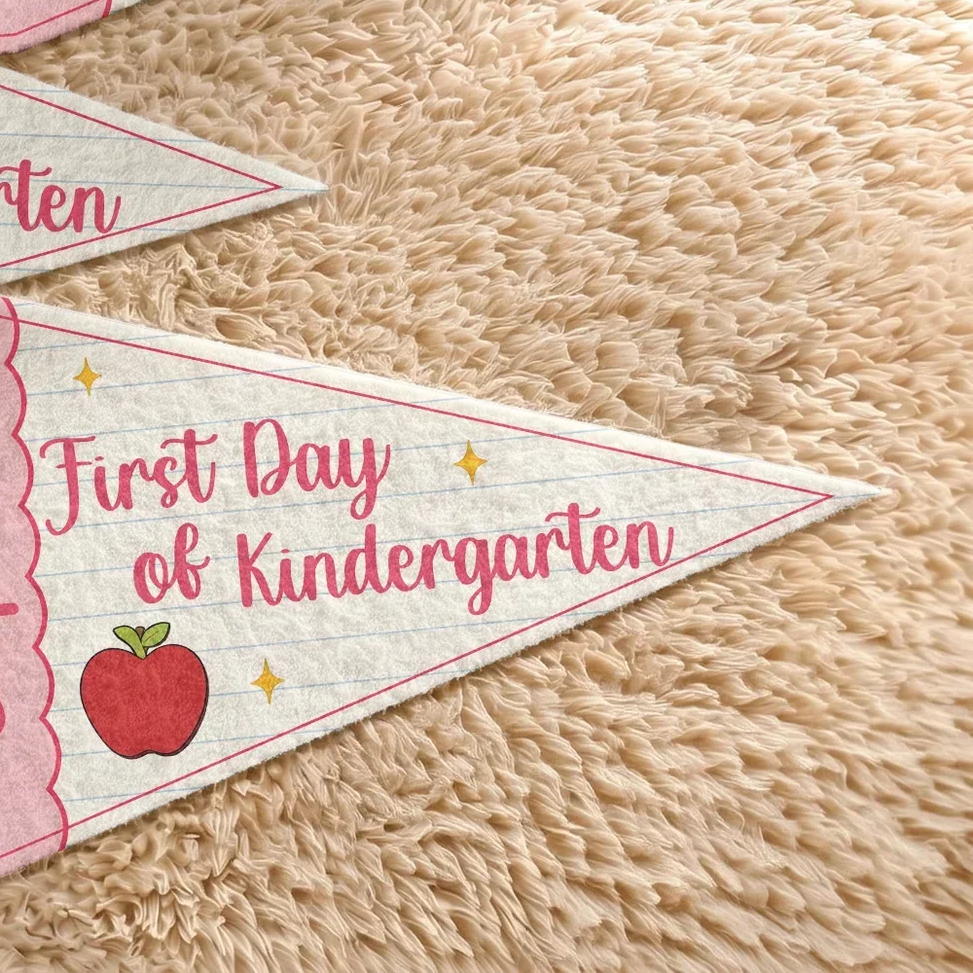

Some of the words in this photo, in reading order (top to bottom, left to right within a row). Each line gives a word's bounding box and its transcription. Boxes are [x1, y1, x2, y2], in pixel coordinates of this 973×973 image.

[39, 429, 217, 535] First
[244, 419, 391, 519] Day
[133, 523, 211, 603] of
[238, 504, 675, 616] Kindergarten
